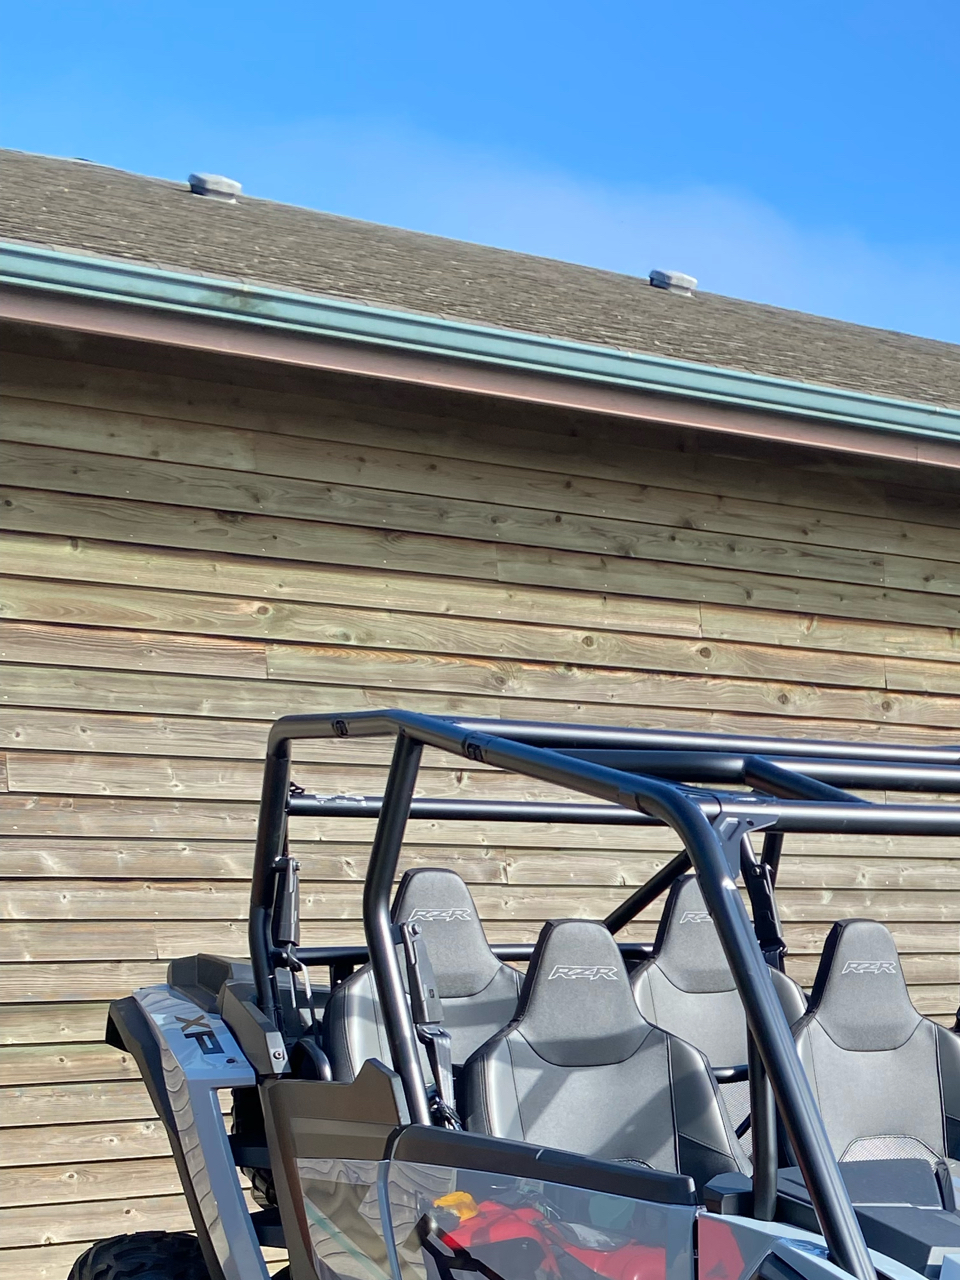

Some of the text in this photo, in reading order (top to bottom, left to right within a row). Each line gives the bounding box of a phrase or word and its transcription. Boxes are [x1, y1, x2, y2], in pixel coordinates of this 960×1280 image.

[408, 908, 471, 921] RZR
[548, 965, 619, 980] RZR
[841, 960, 896, 974] RZR
[174, 1014, 225, 1055] XP
